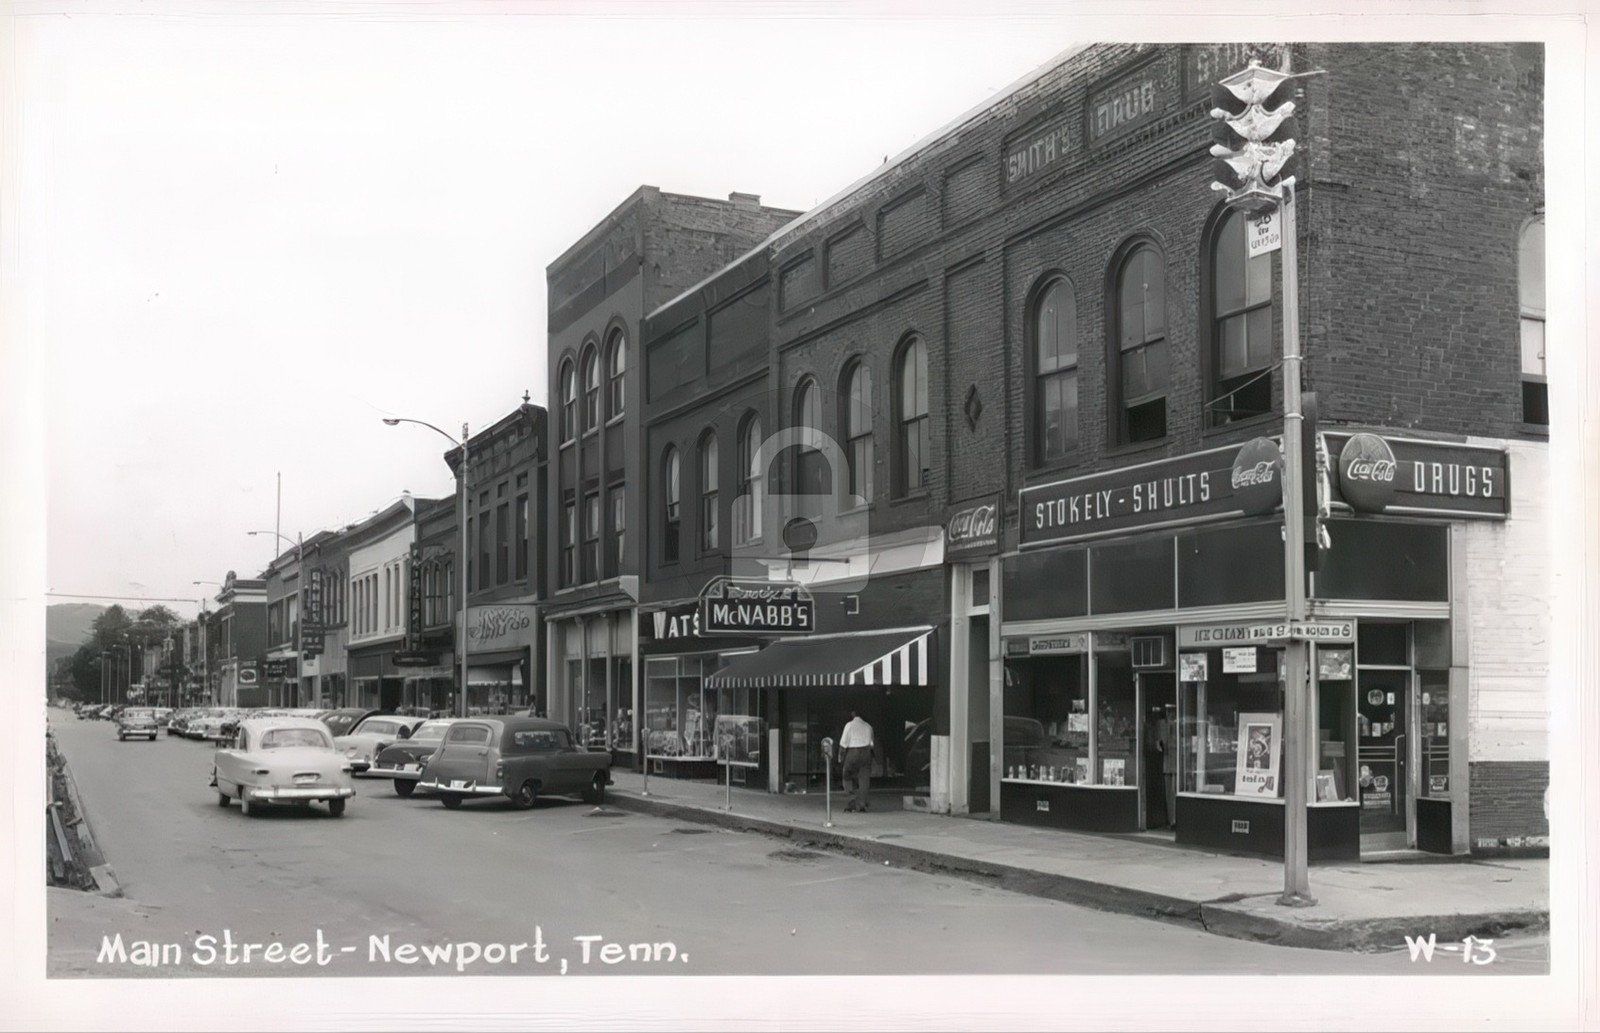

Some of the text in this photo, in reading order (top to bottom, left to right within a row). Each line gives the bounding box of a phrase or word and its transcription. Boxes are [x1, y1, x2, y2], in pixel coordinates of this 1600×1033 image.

[1414, 461, 1493, 498] DRUGS
[1036, 489, 1112, 529] STOKELY
[1133, 471, 1211, 512] SHULTS
[713, 602, 808, 627] McNABB'S
